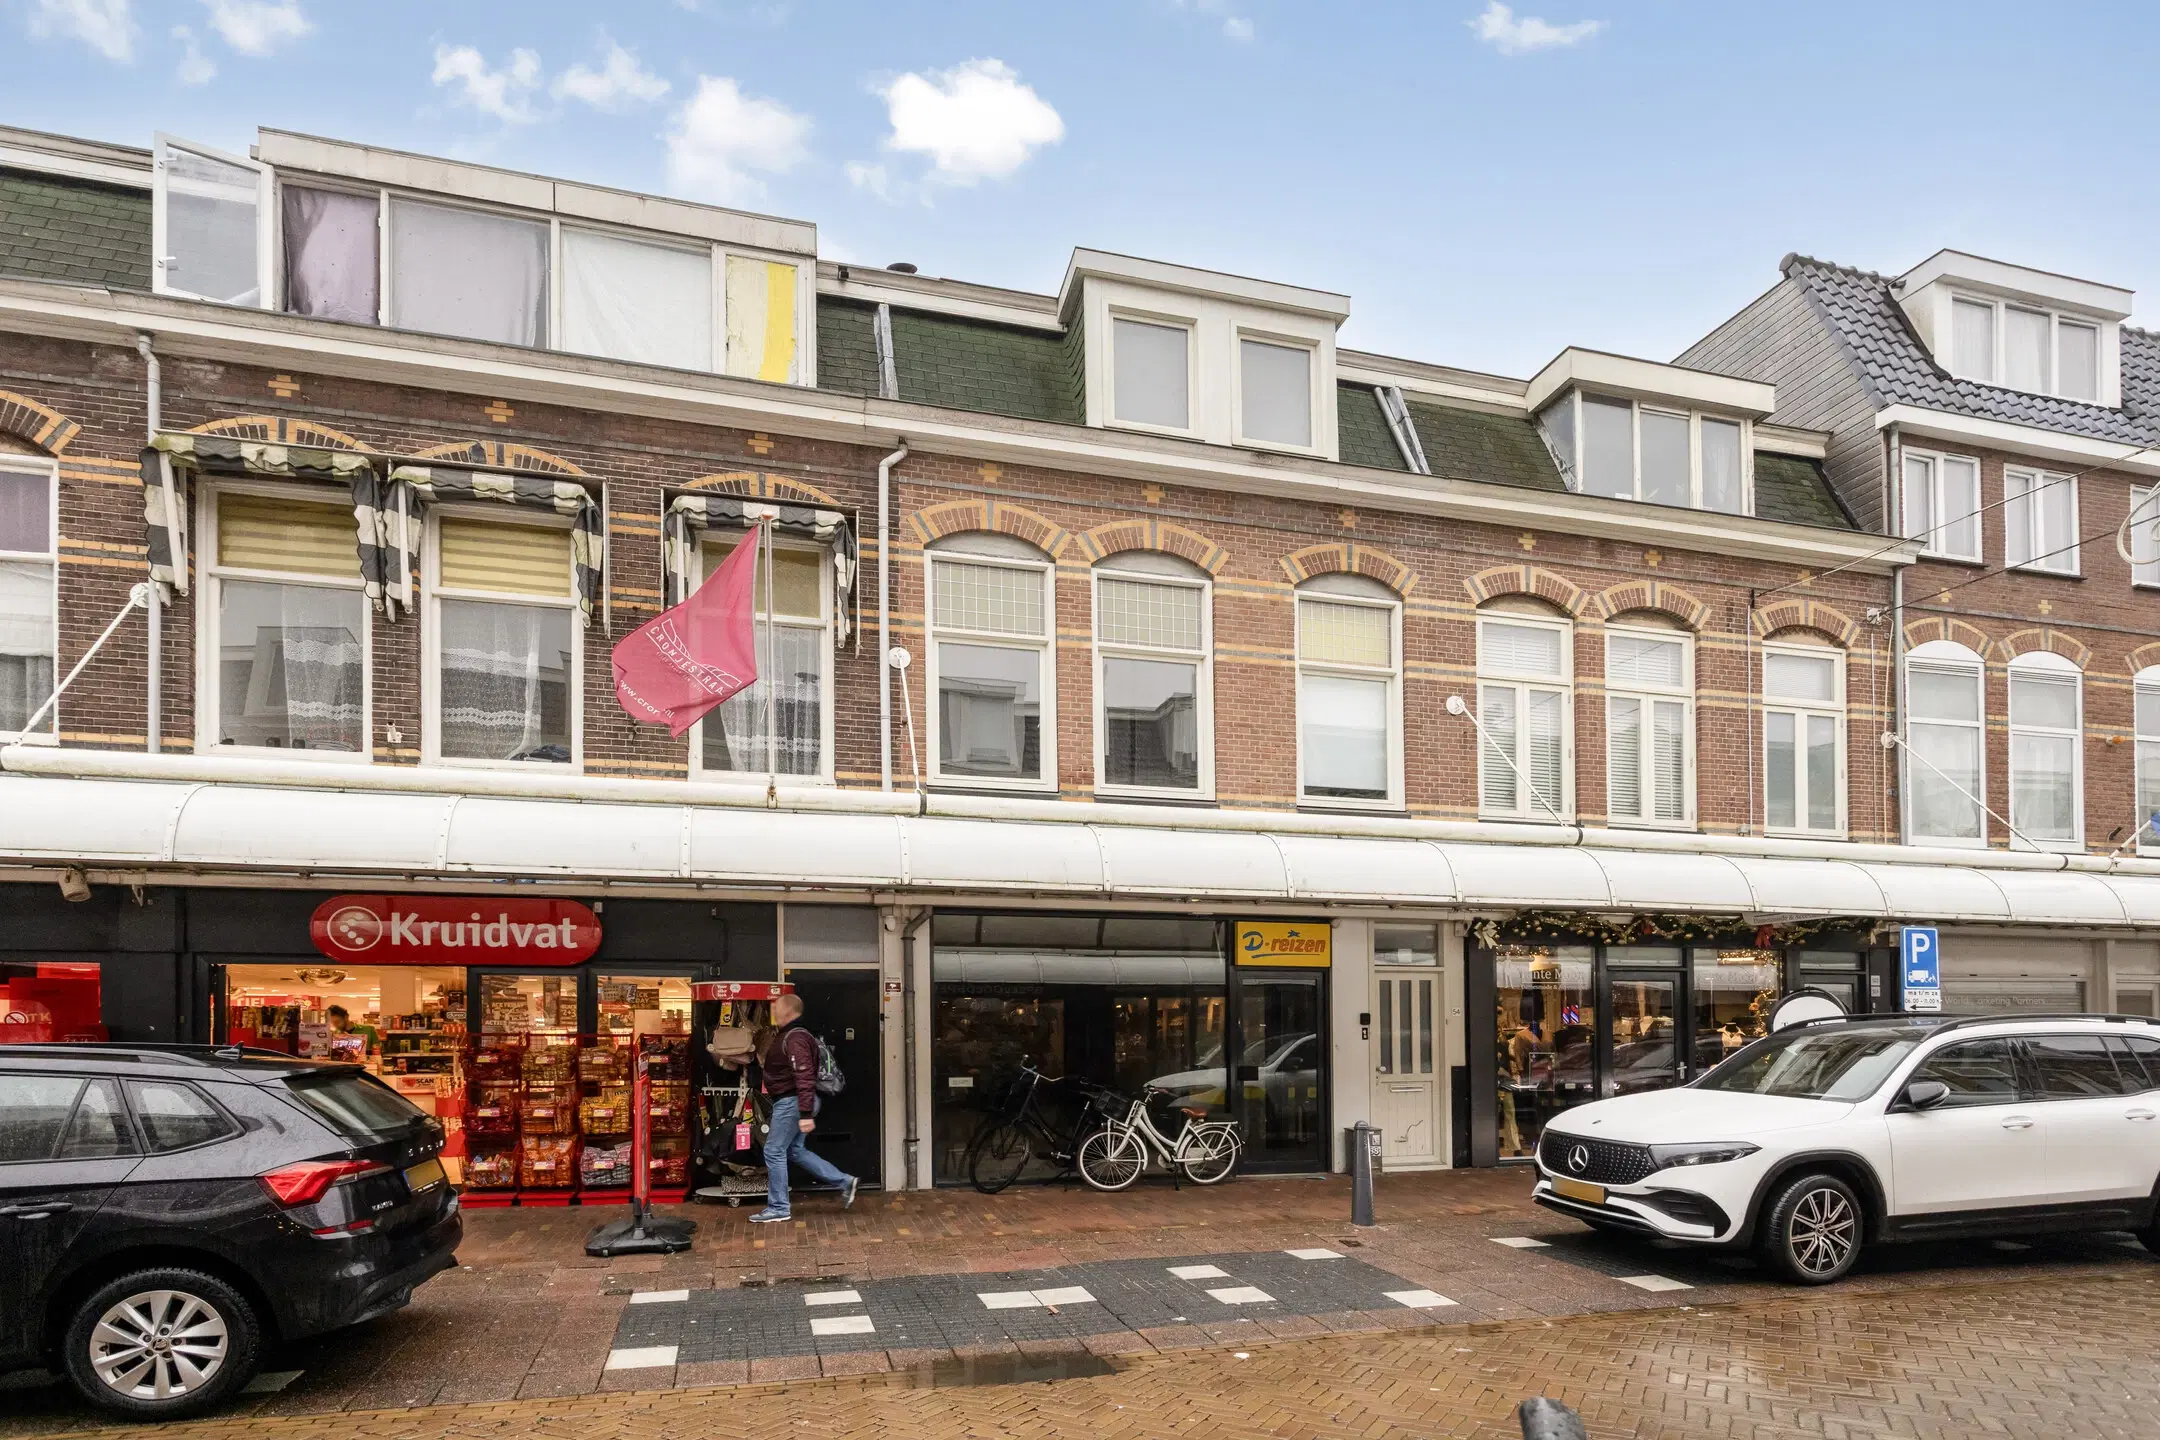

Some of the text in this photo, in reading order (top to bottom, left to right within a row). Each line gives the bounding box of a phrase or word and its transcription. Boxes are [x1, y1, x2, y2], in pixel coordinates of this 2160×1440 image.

[391, 912, 578, 949] Kruidvat
[1243, 929, 1326, 953] D-reizen
[1911, 933, 1930, 964] P
